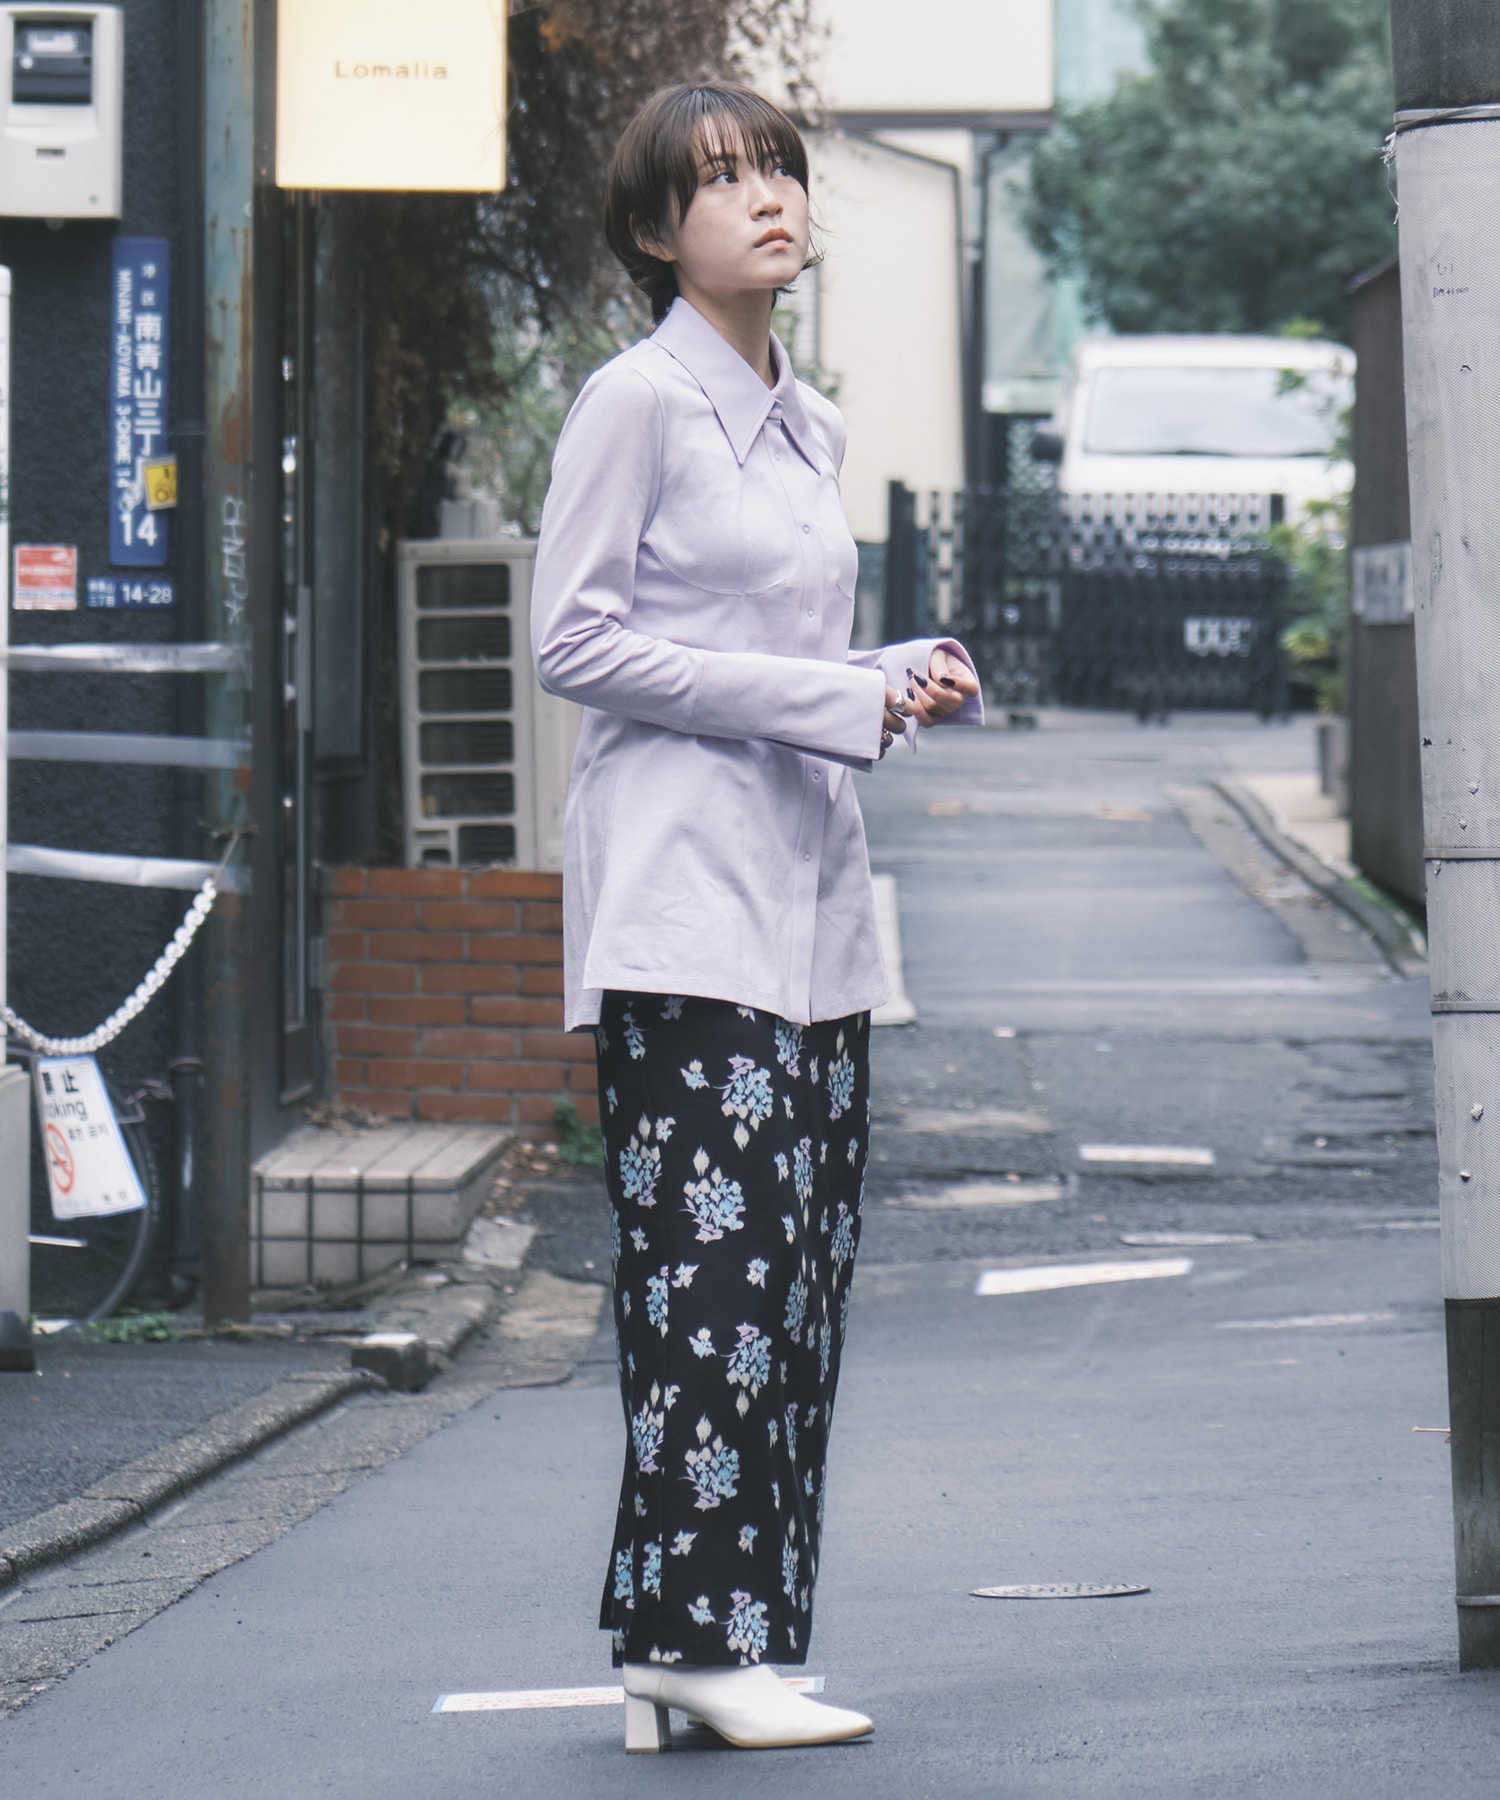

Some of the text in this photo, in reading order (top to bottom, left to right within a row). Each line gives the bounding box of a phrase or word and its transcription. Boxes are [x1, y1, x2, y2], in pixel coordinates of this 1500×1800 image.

[335, 60, 448, 79] Lomalia
[116, 269, 132, 398] MINAMI-AOYAMA
[119, 512, 158, 546] 14
[122, 584, 173, 604] 14-28
